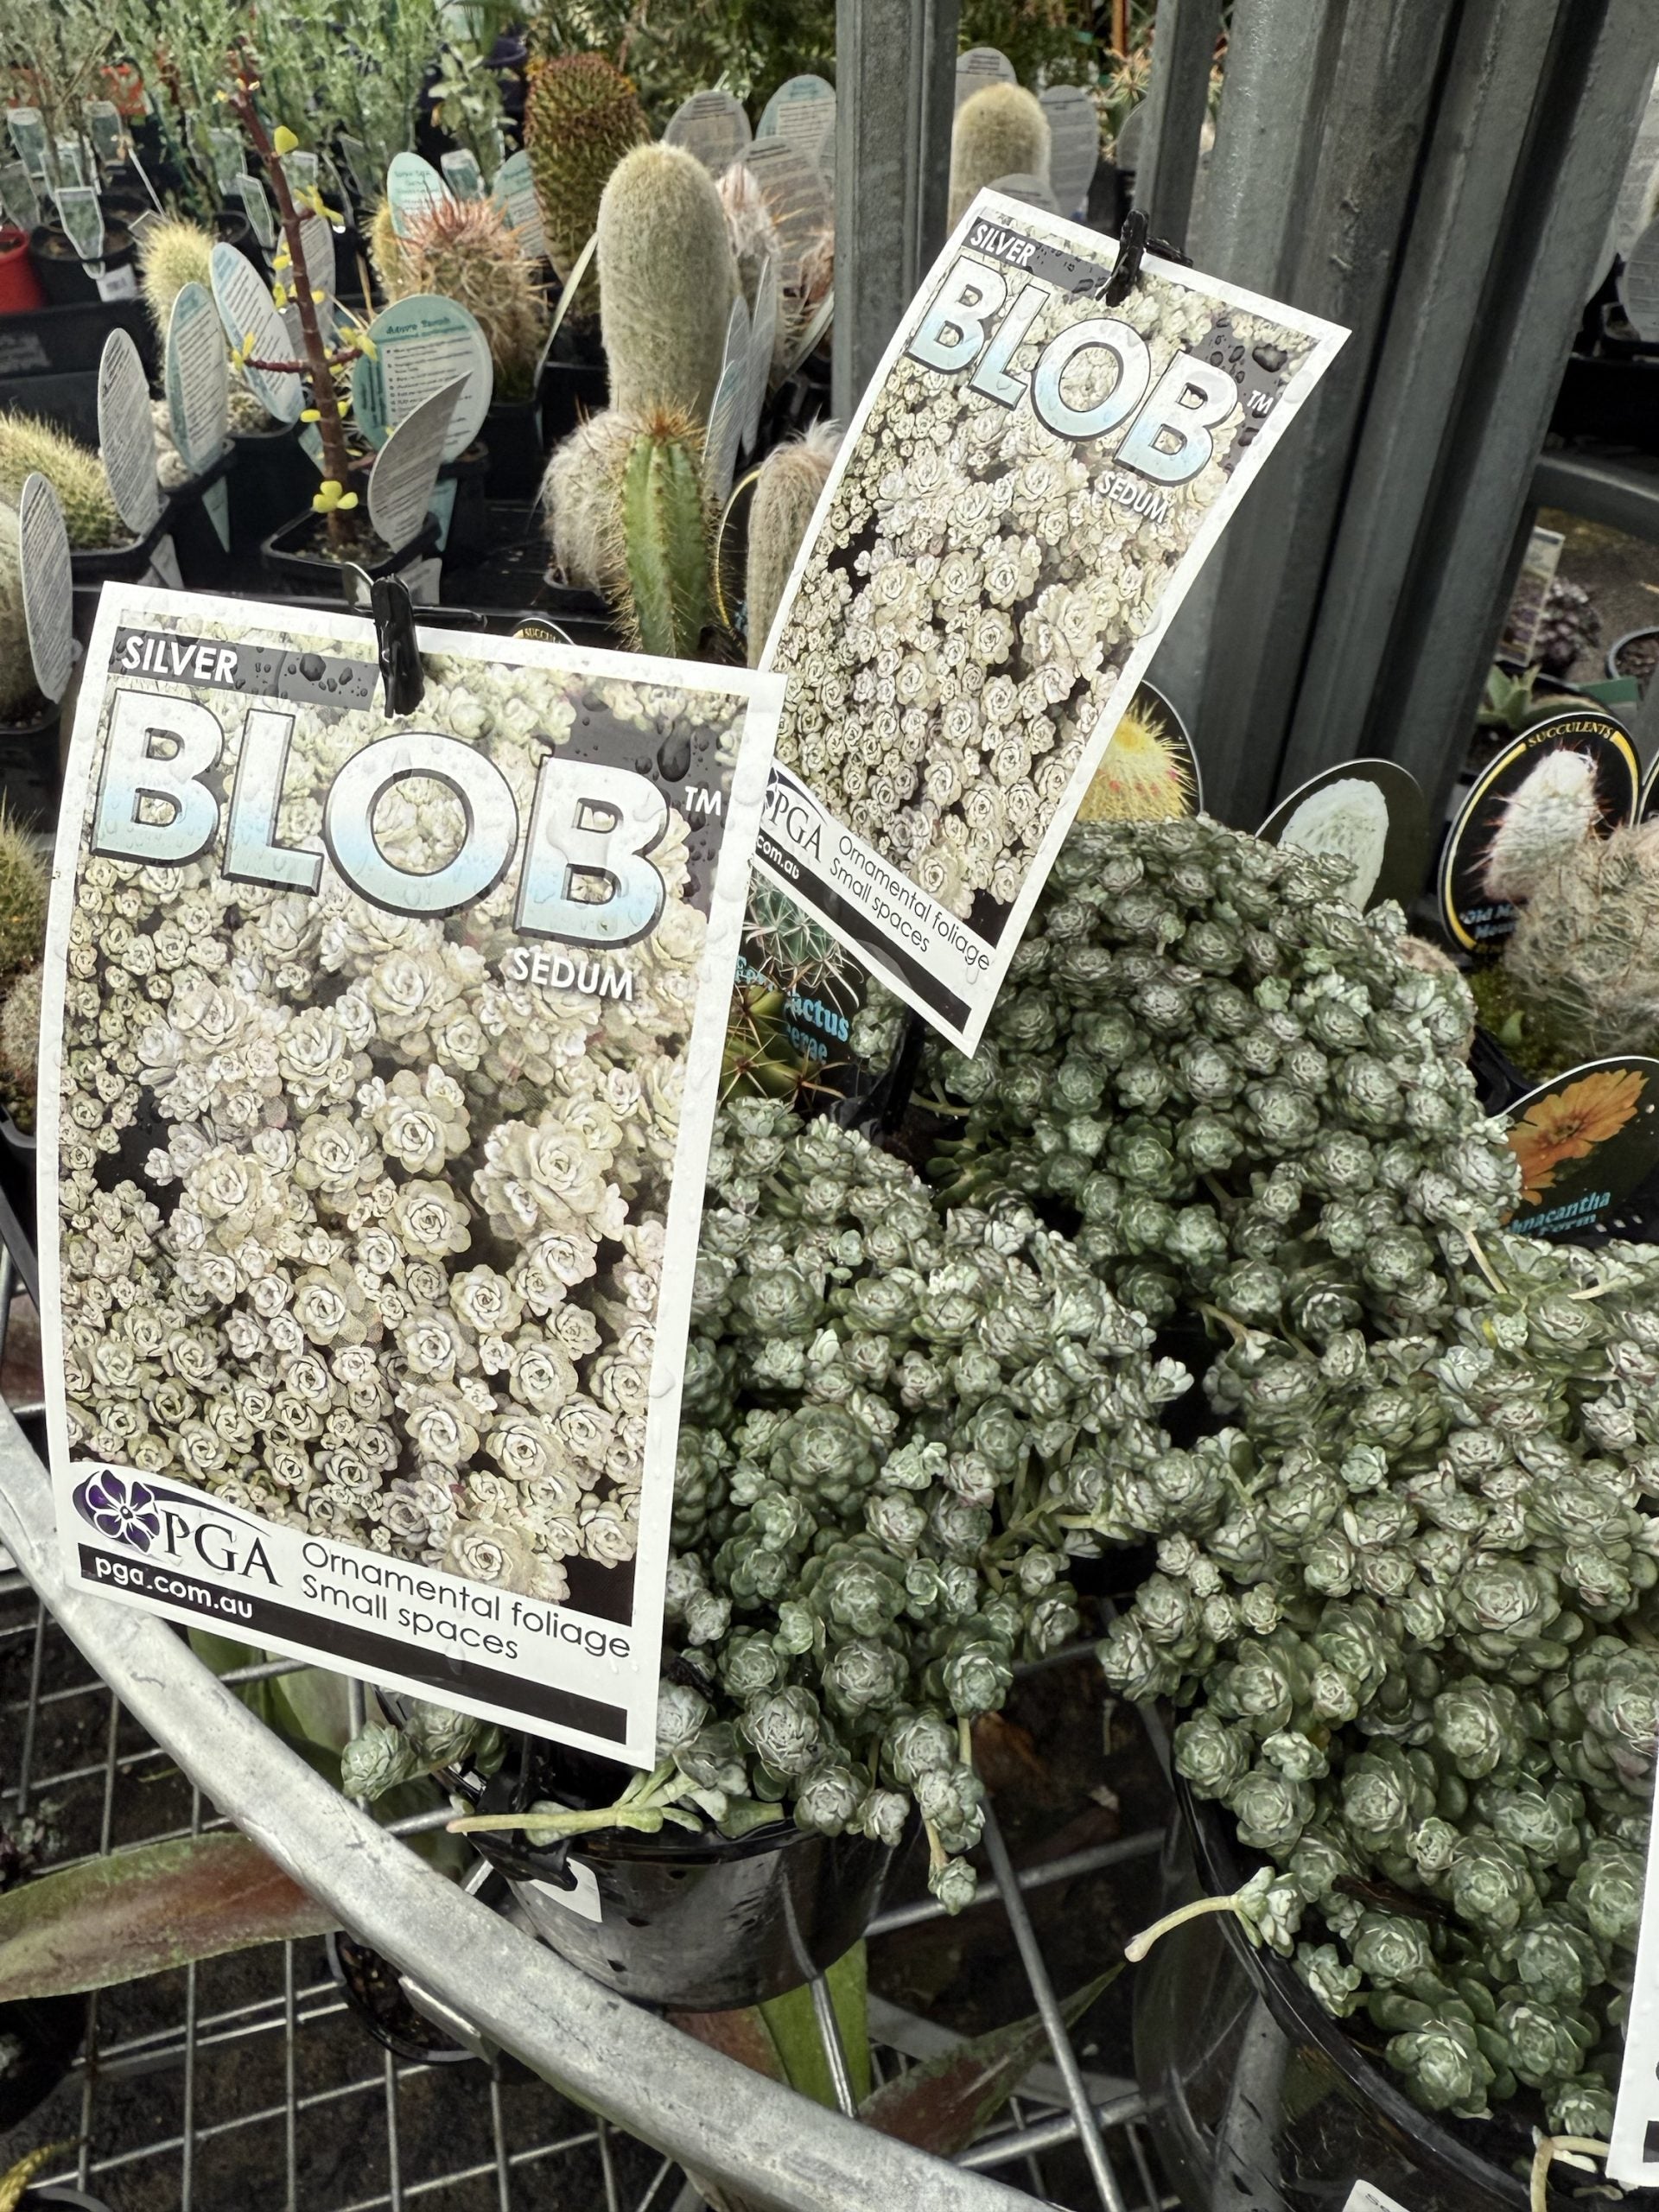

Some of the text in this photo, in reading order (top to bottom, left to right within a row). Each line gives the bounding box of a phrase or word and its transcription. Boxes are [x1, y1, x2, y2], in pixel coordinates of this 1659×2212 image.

[969, 224, 1037, 266] SILVER
[903, 255, 1238, 486] BLOB
[1098, 471, 1169, 523] SEDUM
[122, 636, 238, 683] SILVER
[1528, 721, 1613, 747] SUCCULENTS
[90, 688, 670, 950] BLOB
[769, 791, 822, 862] PGA
[830, 857, 930, 952] Small spaces
[838, 835, 990, 970] Ornamental foliage
[513, 947, 634, 1001] SEDUM
[788, 994, 849, 1042] actus
[1509, 1192, 1611, 1234] hnacantha
[161, 1509, 283, 1587] PGA
[94, 1555, 254, 1619] pga.com.au
[302, 1541, 632, 1658] Ornamental foliage
[302, 1574, 518, 1660] Small spaces
